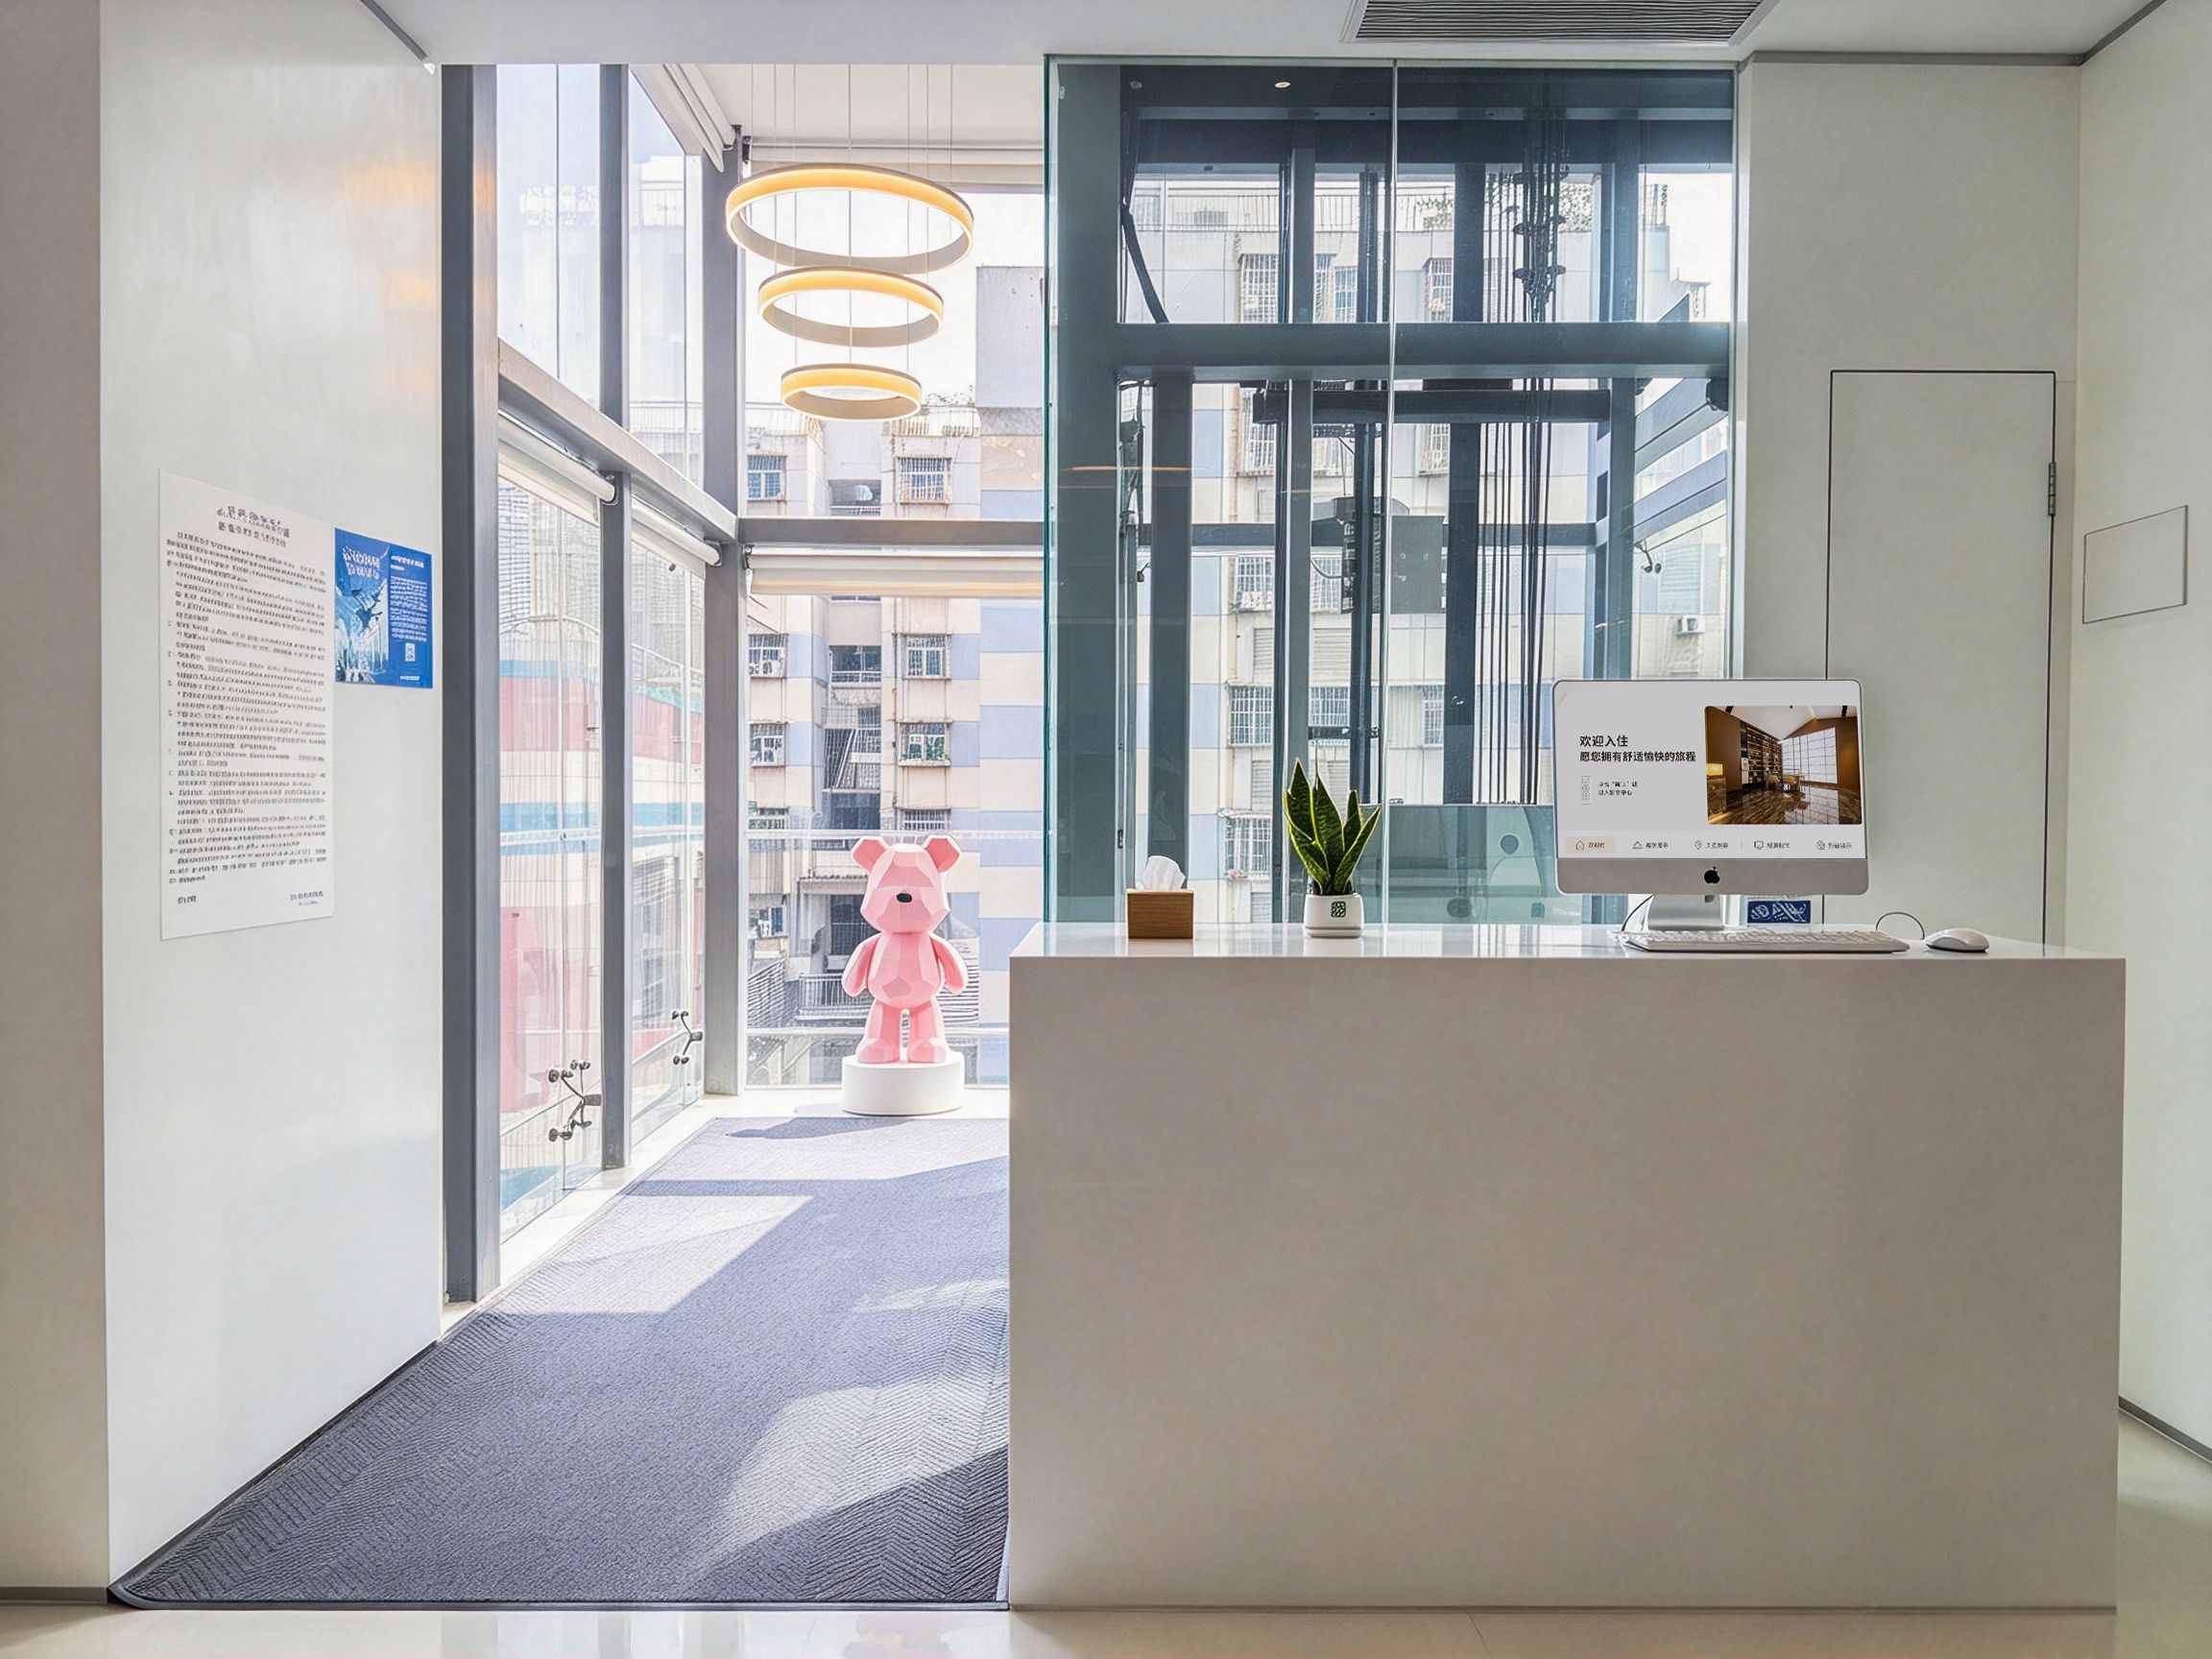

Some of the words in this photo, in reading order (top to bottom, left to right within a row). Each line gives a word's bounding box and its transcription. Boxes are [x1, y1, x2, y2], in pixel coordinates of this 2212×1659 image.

[1579, 734, 1629, 747] 欢迎入住
[1579, 751, 1697, 762] 愿您拥有舒适愉快的旅程
